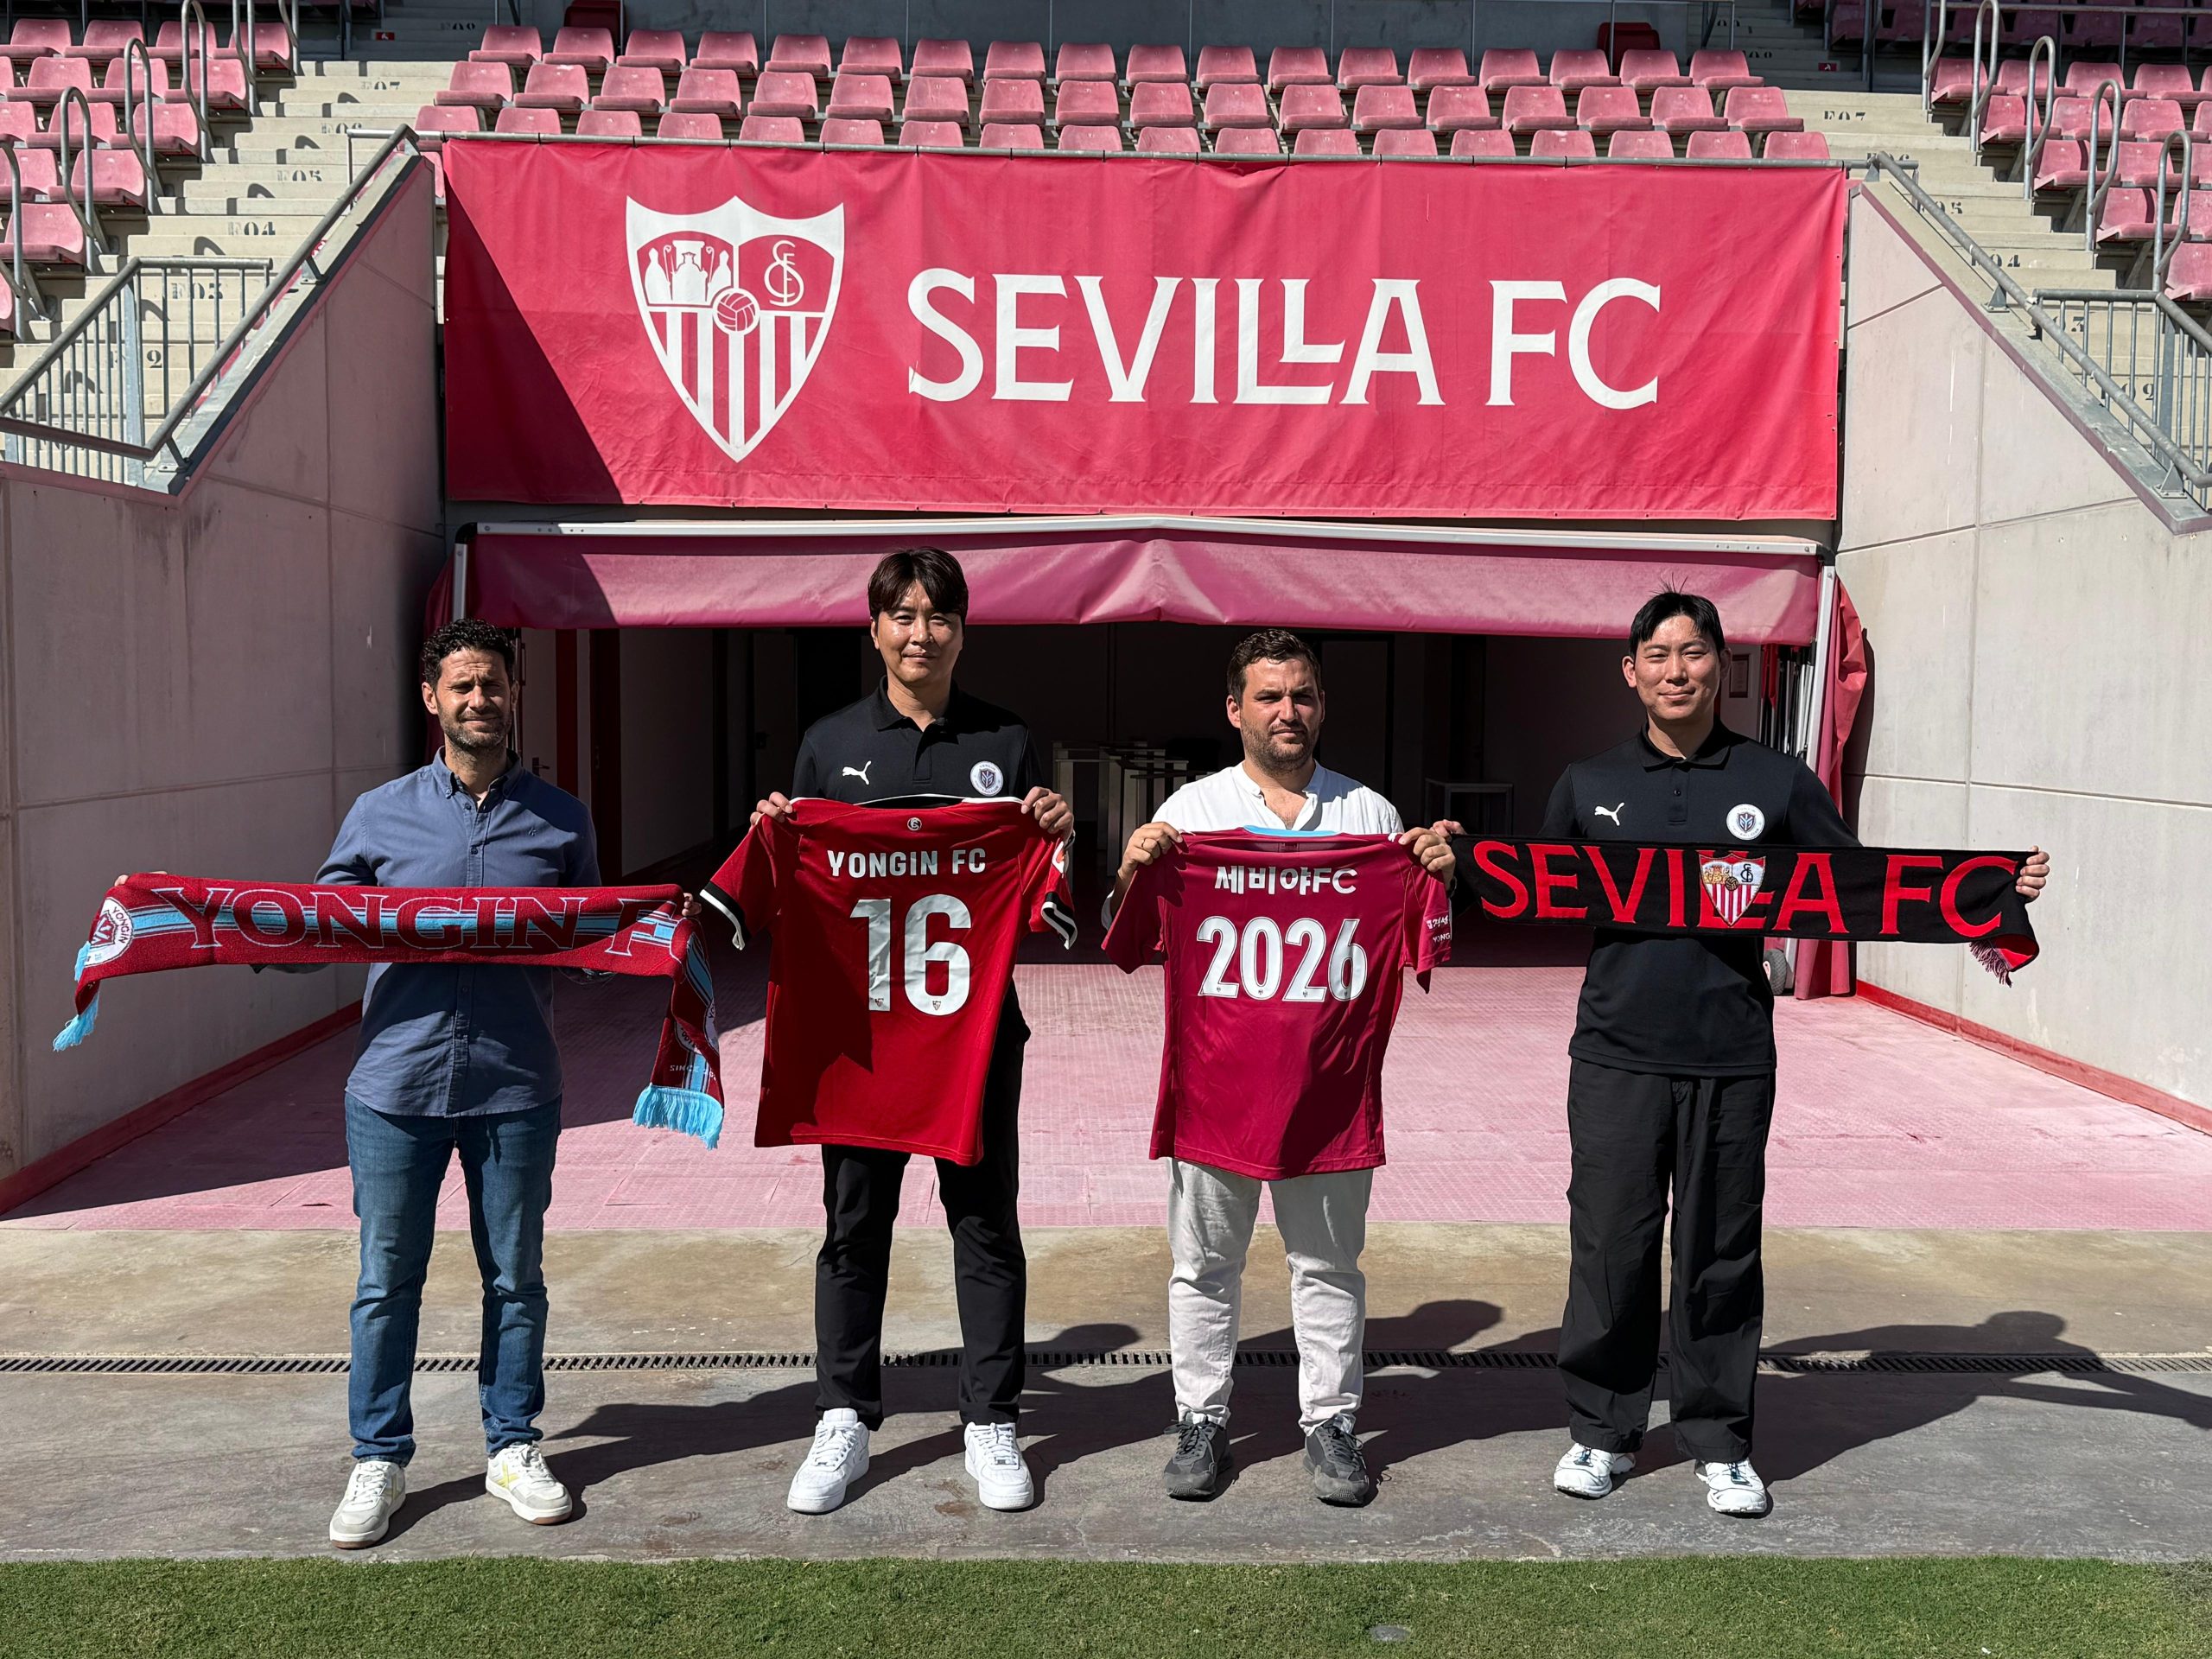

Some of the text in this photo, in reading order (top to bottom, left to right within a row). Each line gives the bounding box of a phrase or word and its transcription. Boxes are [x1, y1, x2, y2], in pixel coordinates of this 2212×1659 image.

[907, 268, 1661, 410] SEVILLA FC
[827, 849, 986, 878] YONGIN FC
[1214, 865, 1358, 895] 세비야FC
[1878, 854, 2019, 938] FC
[111, 906, 130, 944] YONGIN
[151, 887, 586, 950] YONGIN
[849, 893, 971, 1016] 16
[1197, 915, 1368, 1002] 2026
